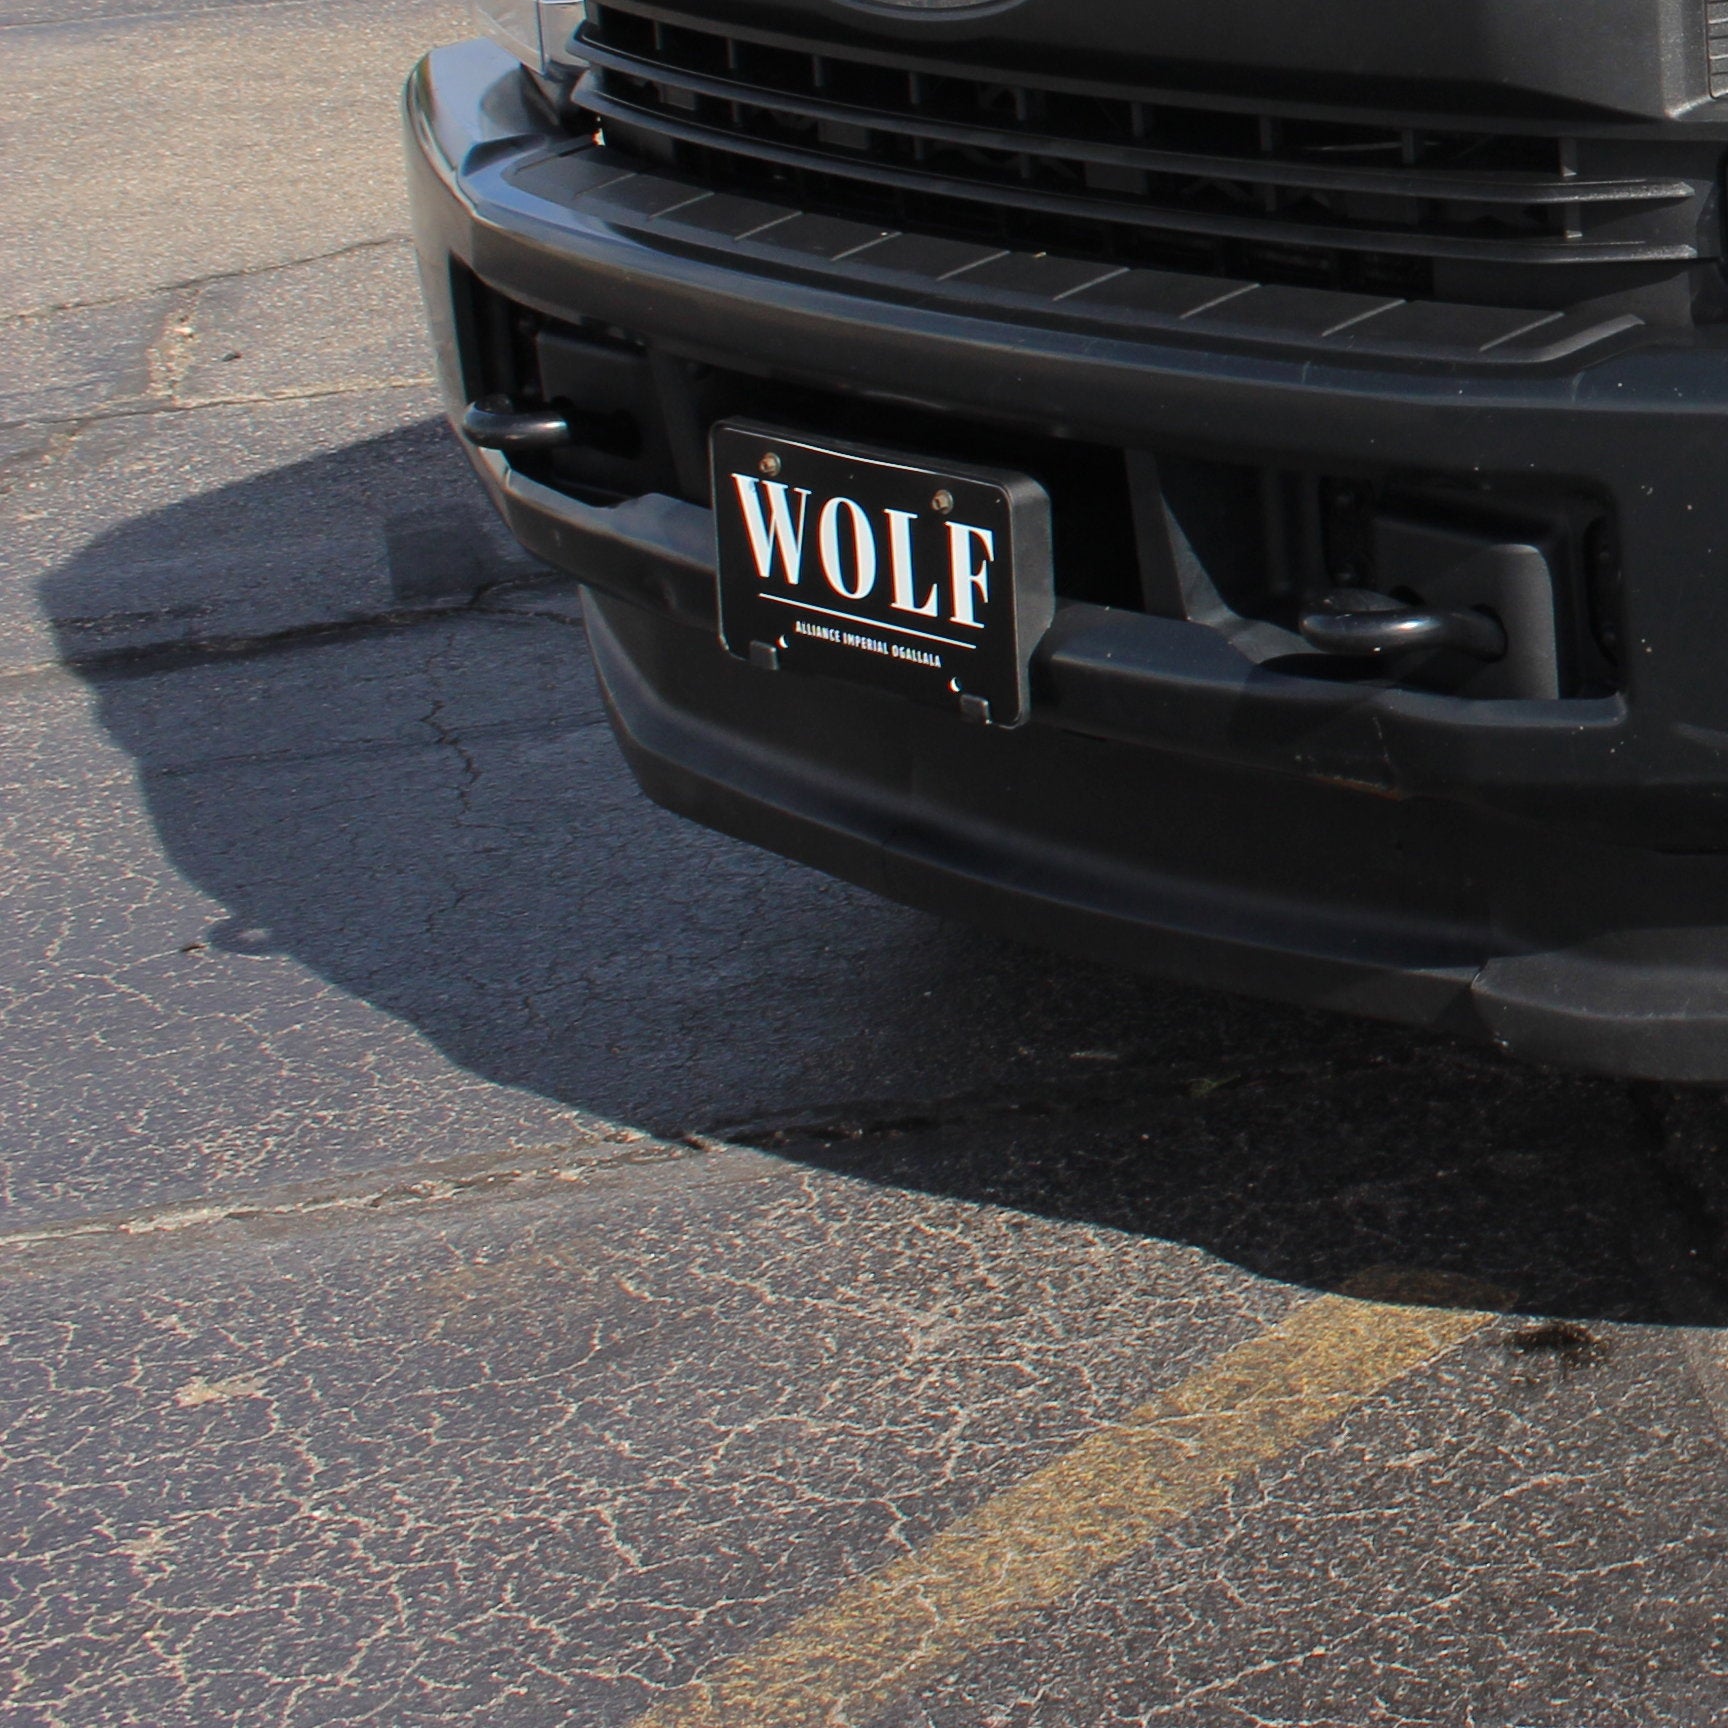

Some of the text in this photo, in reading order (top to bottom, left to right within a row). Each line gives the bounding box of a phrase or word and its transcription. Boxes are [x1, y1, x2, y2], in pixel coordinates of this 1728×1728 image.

[731, 473, 995, 628] WOLF
[796, 621, 942, 669] ALLIANCE IMPERIAL OGALLALA
